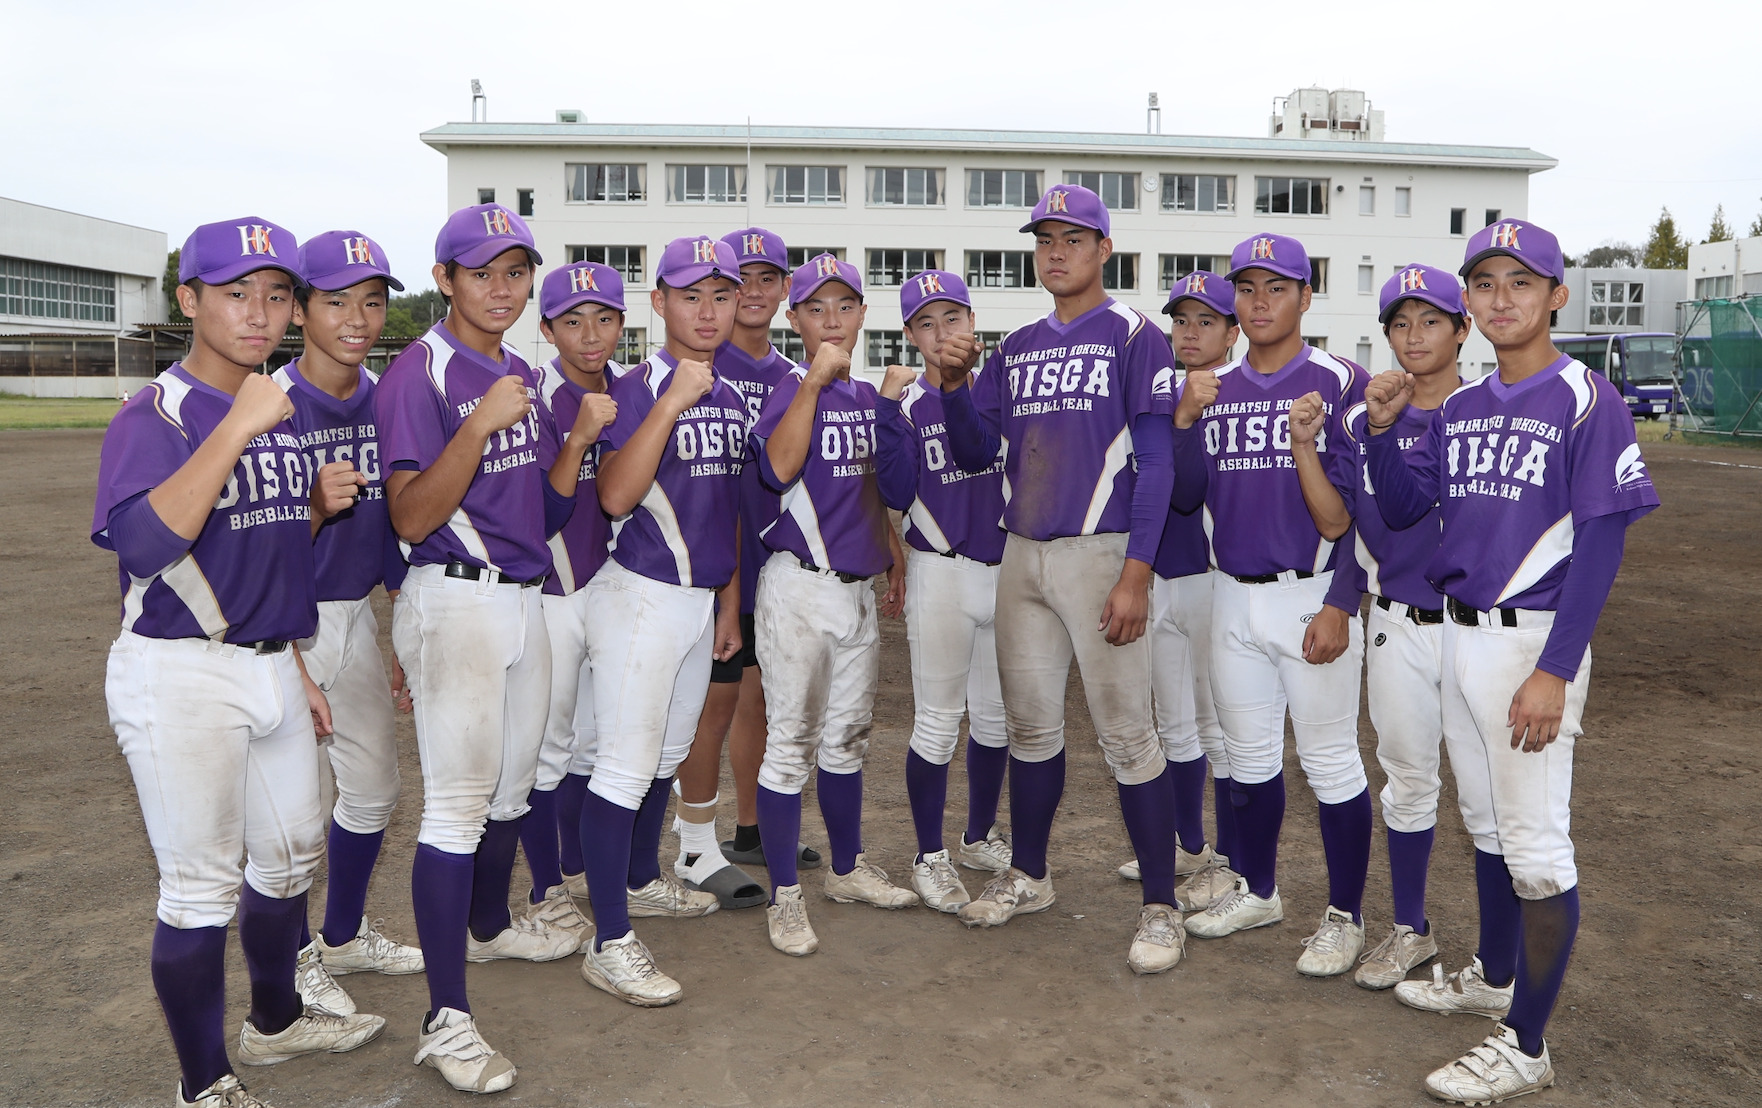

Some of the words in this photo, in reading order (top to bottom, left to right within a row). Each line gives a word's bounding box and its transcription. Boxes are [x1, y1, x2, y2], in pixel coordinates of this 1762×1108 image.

[1069, 344, 1116, 357] KOKUSAI
[1008, 358, 1110, 400] OISCA
[676, 406, 722, 421] AMAMATSU
[1013, 400, 1060, 417] ASEBALL
[1062, 397, 1092, 411] TEAM
[1202, 400, 1271, 419] HAMAMATSU
[299, 426, 353, 449] MAMATSU
[676, 422, 745, 460] OISC
[821, 424, 877, 460] OIS
[1217, 457, 1272, 472] ASEBALL
